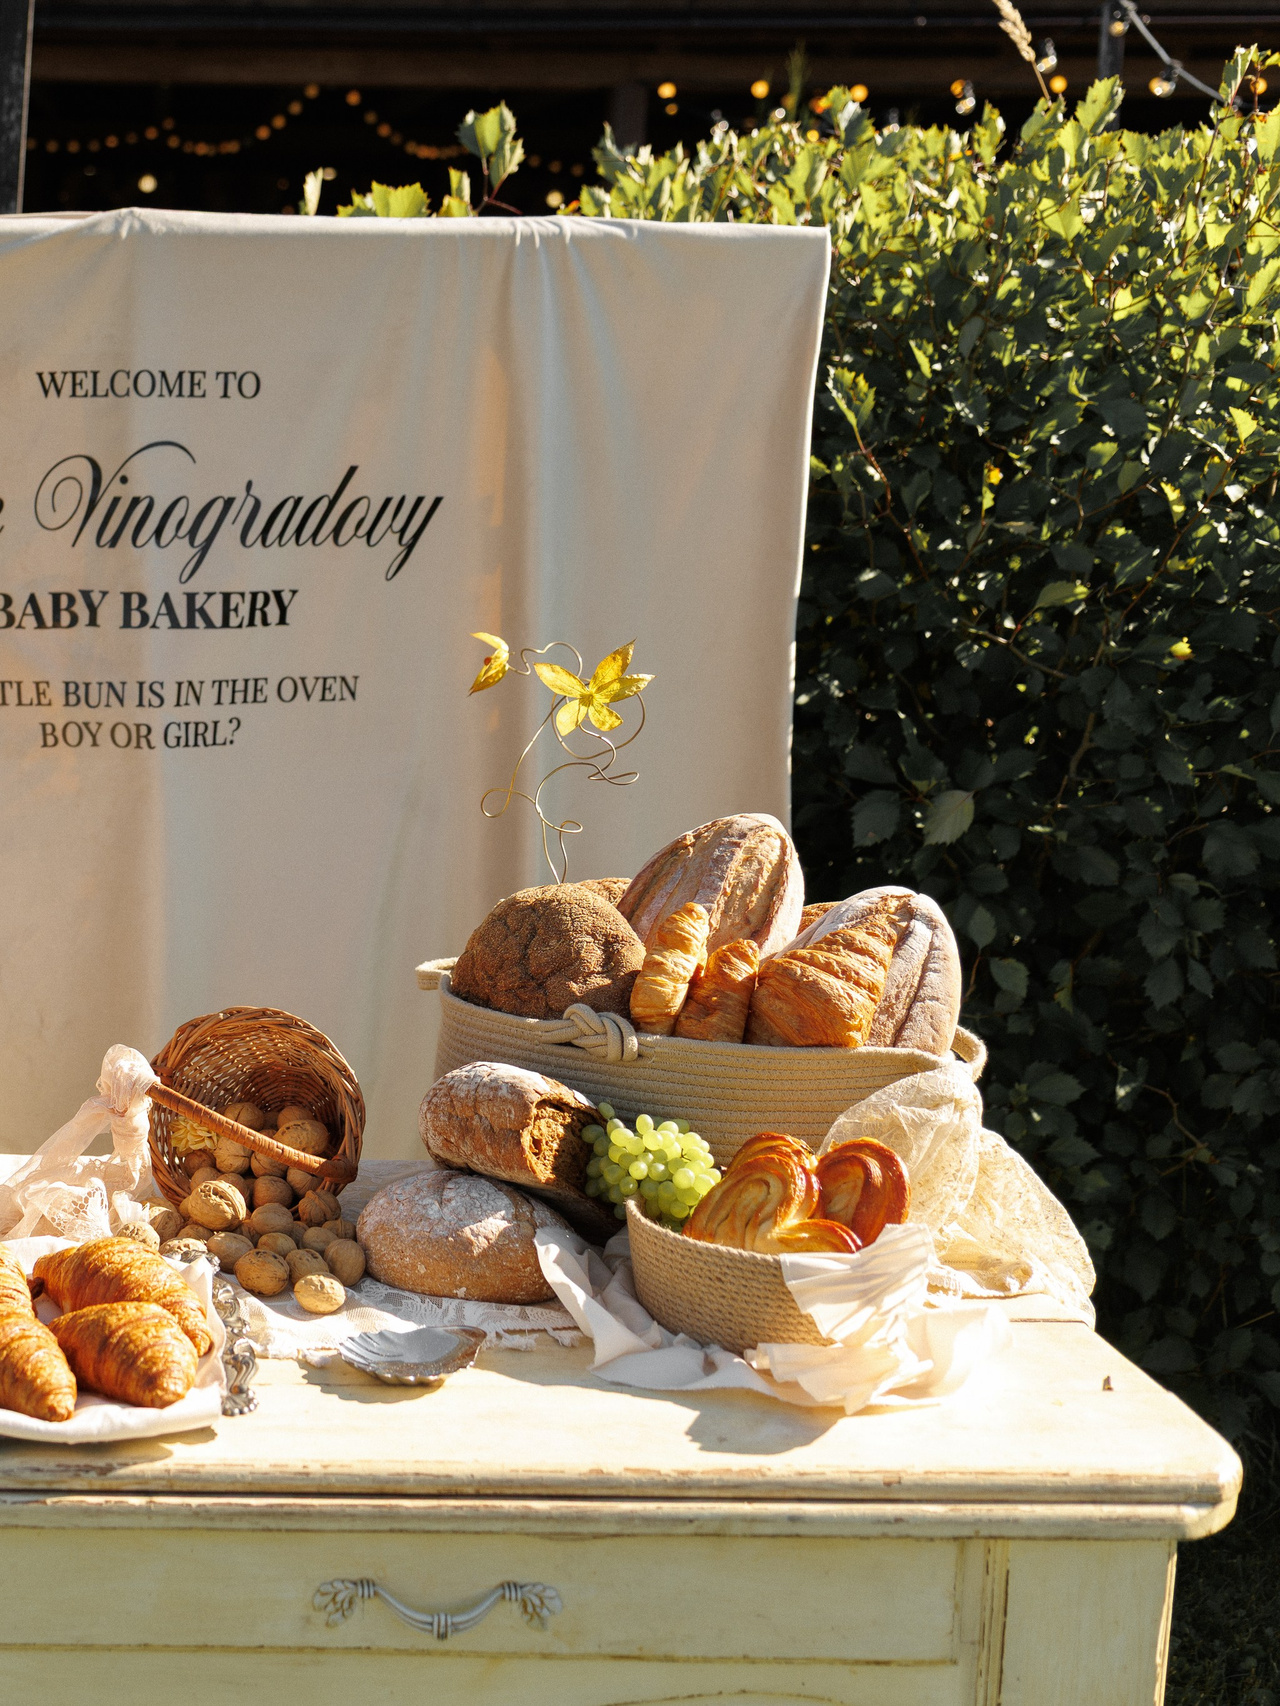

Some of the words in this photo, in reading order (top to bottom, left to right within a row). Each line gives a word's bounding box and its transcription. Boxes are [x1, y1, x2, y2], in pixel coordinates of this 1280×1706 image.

[35, 368, 207, 399] WELCOME
[214, 370, 262, 400] TO
[33, 439, 445, 585] Vinogradovy
[118, 588, 300, 631] BAKERY
[61, 680, 128, 710] BUN
[135, 680, 166, 709] IS
[173, 679, 206, 708] IN
[210, 676, 269, 707] THE
[275, 674, 361, 704] OVEN
[38, 720, 104, 749] BOY
[109, 721, 157, 751] OR
[162, 716, 242, 750] GIRL?
